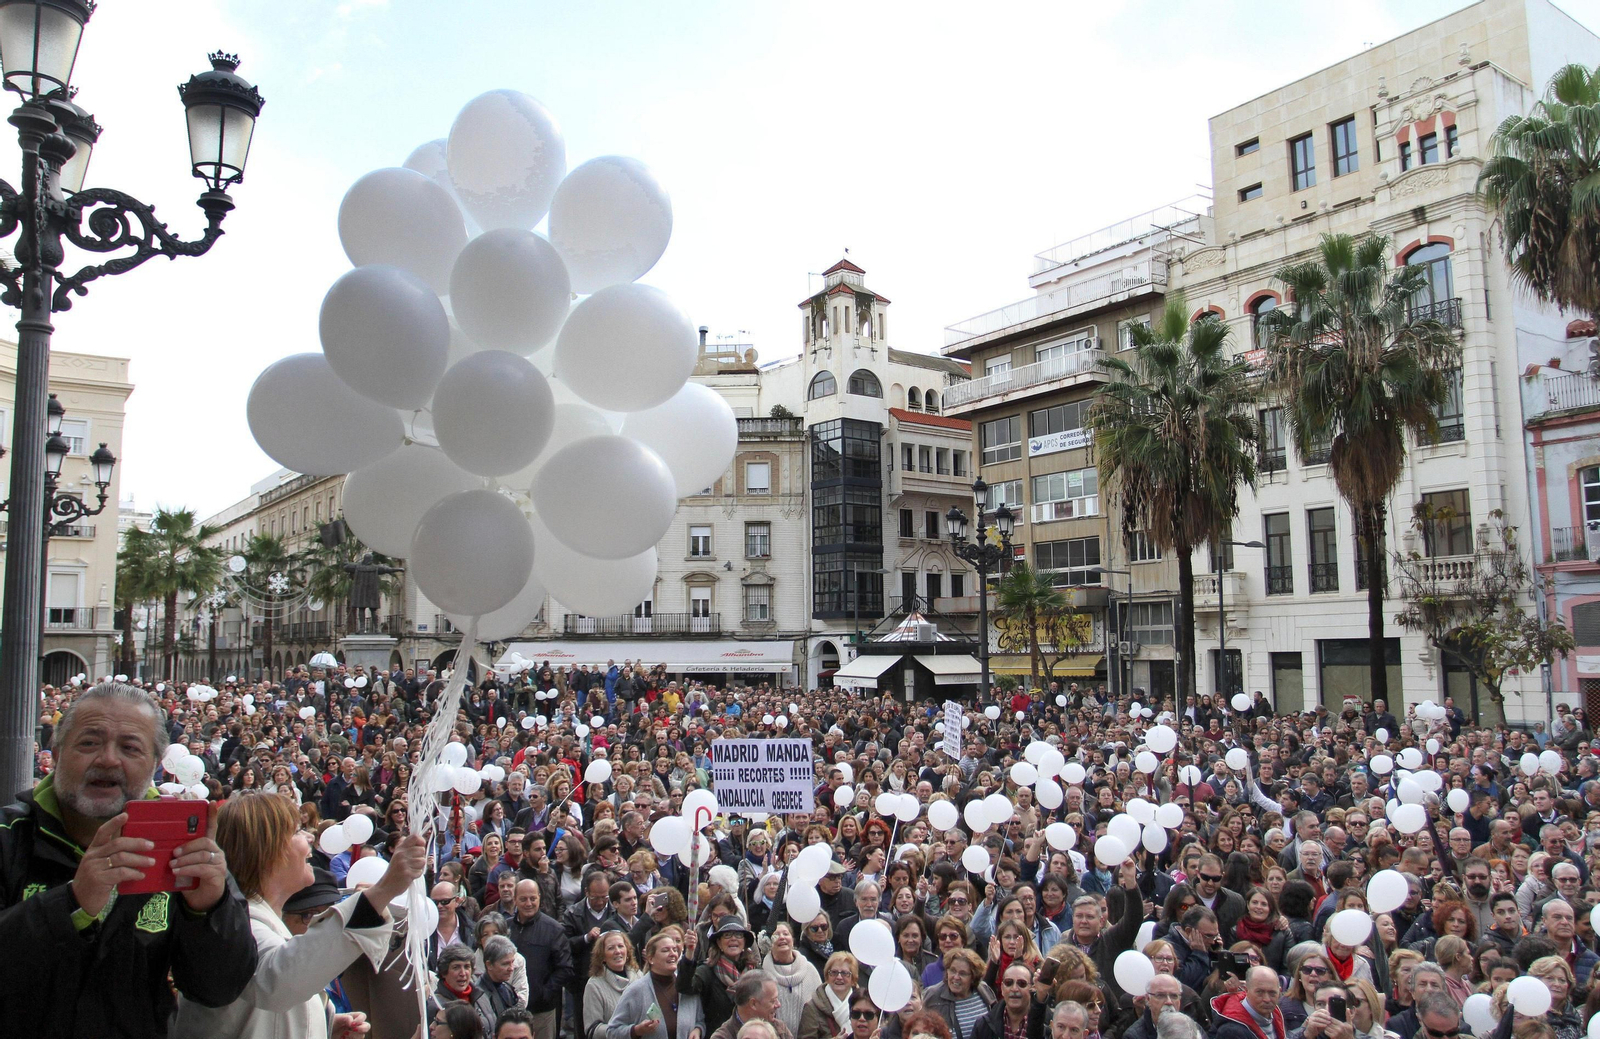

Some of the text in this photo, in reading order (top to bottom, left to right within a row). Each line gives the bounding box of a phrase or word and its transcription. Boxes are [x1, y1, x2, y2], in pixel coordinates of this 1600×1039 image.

[1043, 437, 1059, 449] APCS
[714, 743, 809, 763] MADRID MANDA
[738, 767, 785, 783] RECORTES
[717, 788, 803, 810] ANDALUCIA OBEDECE
